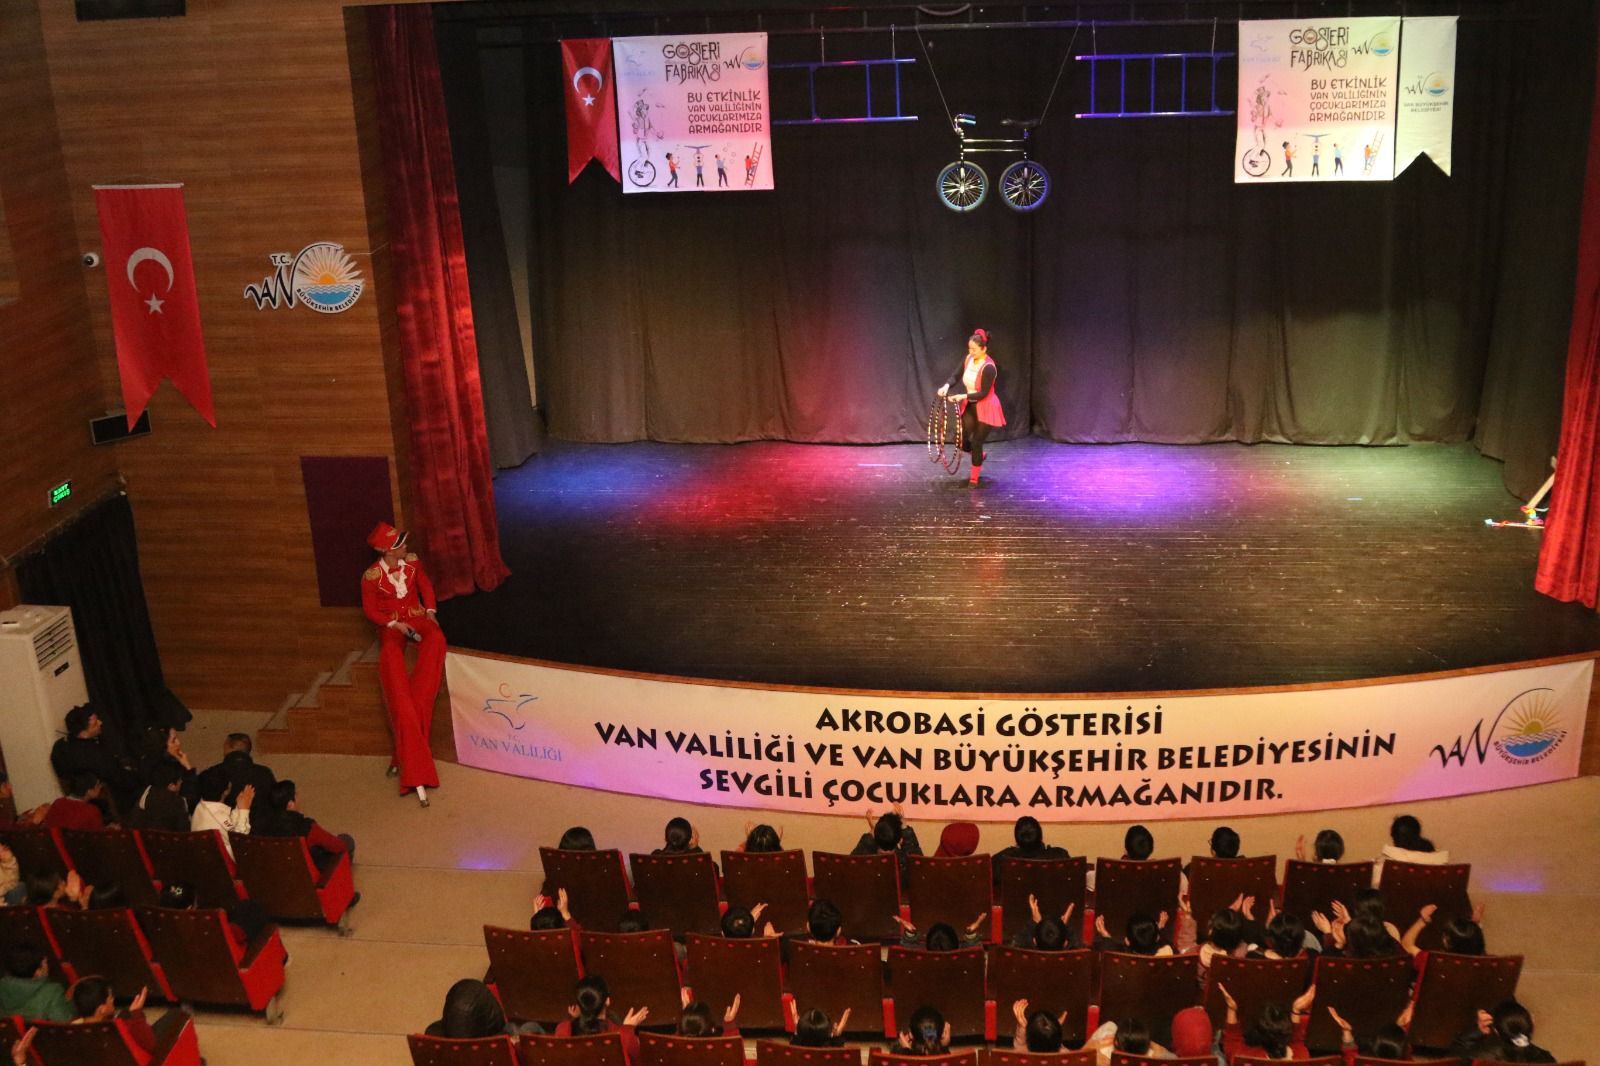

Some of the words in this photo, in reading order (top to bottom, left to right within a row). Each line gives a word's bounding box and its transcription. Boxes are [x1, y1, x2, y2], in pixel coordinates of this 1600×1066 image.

[1311, 79, 1327, 90] BU
[1331, 75, 1387, 89] ETKİNLİK
[687, 92, 703, 103] BU
[706, 88, 761, 102] ETKİNLİK
[1310, 92, 1329, 100] VAN
[687, 104, 706, 112] VAN
[1309, 100, 1387, 111] ÇOCUKLARIMIZA
[688, 112, 762, 123] ÇOCUKLARIMIZA
[688, 122, 763, 134] ARMAĞANIDIR
[271, 255, 290, 264] T.C.
[815, 706, 985, 736] AKROBASİ
[995, 705, 1163, 737] GÖSTERİSİ
[469, 734, 498, 751] VAN
[594, 721, 657, 750] VAN
[665, 729, 795, 763] VALİLİĞİ
[803, 741, 844, 766] VE
[852, 745, 922, 770] VAN
[933, 742, 1148, 779] BÜYÜKŞEHİR
[1157, 728, 1397, 771] BELEDİYESİNİN
[699, 767, 813, 799] SEVGİLİ
[822, 778, 1021, 808] ÇOCUKLARA
[1028, 776, 1283, 808] ARMAĞANIDIR.
